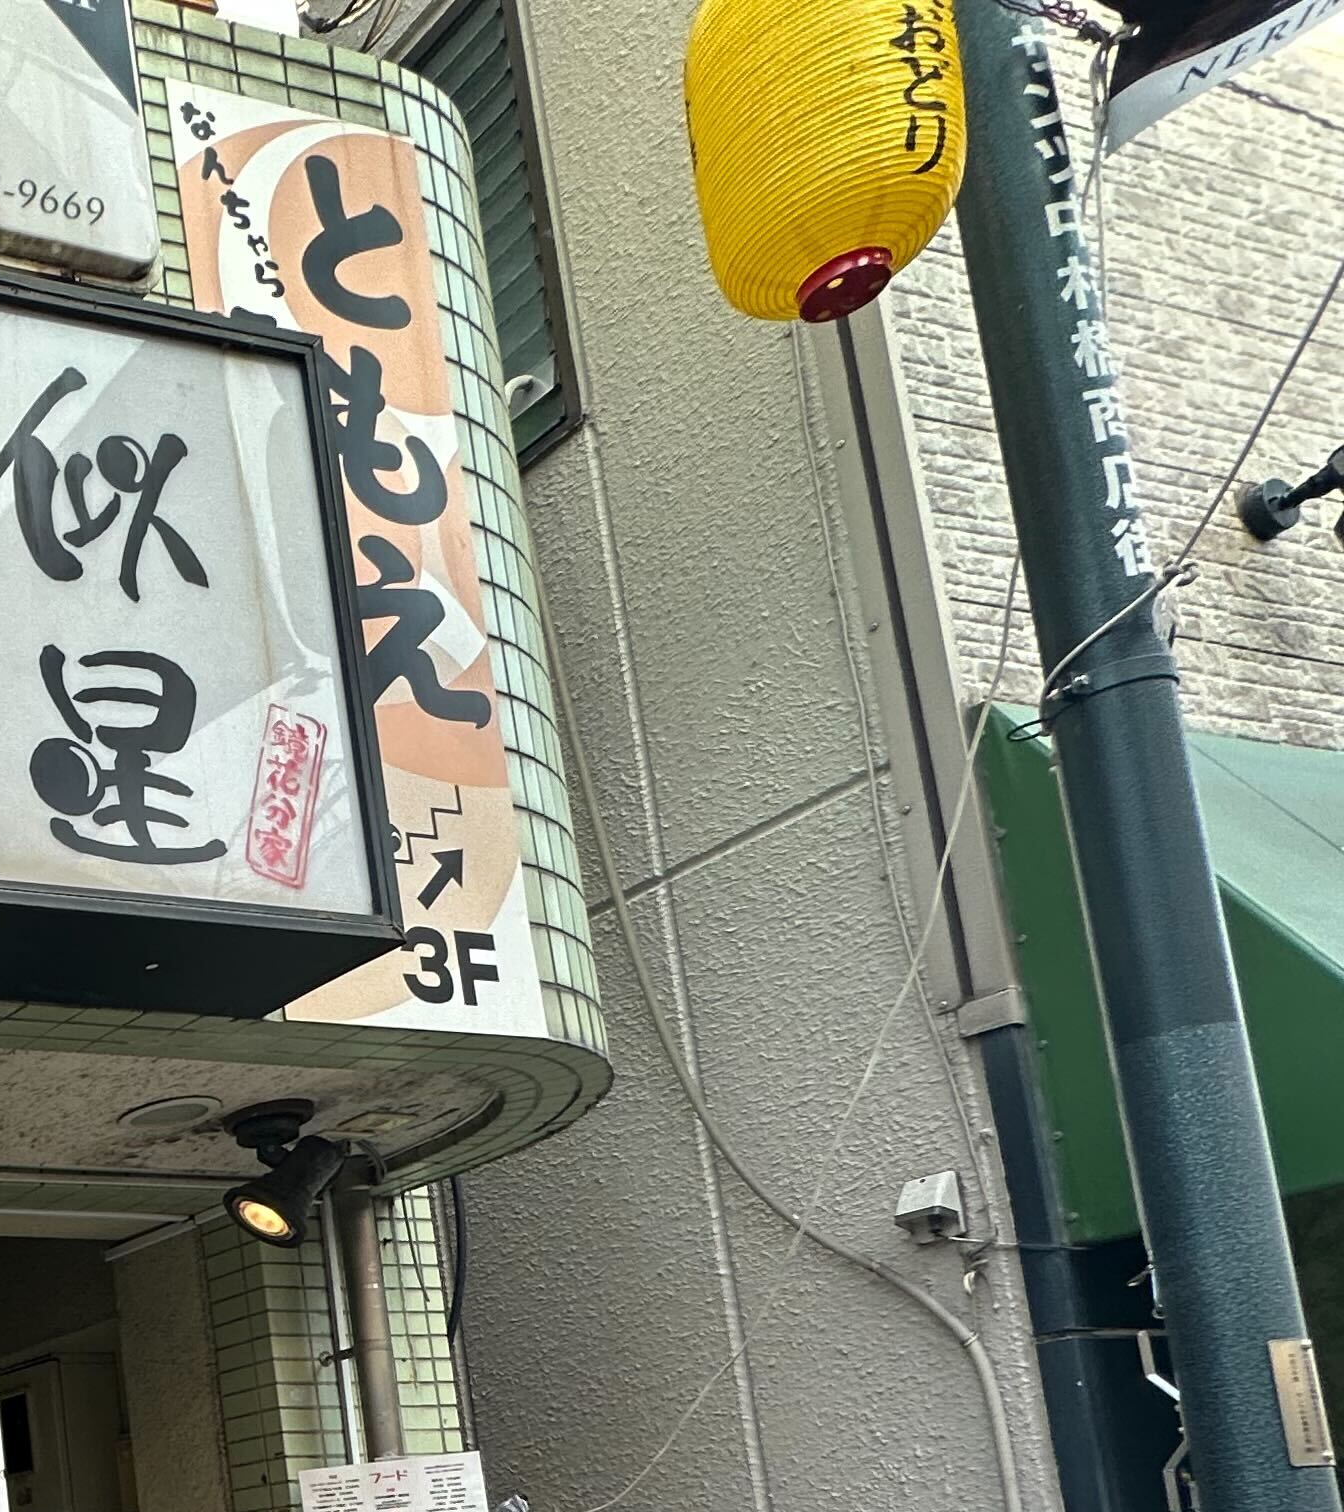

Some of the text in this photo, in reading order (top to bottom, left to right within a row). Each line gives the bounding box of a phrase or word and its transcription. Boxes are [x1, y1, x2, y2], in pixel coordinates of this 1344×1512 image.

[1178, 0, 1344, 93] NERI
[179, 101, 285, 328] なんちゃら
[302, 154, 492, 728] ともえ
[401, 926, 500, 1007] 3F
[369, 1469, 409, 1483] フード
